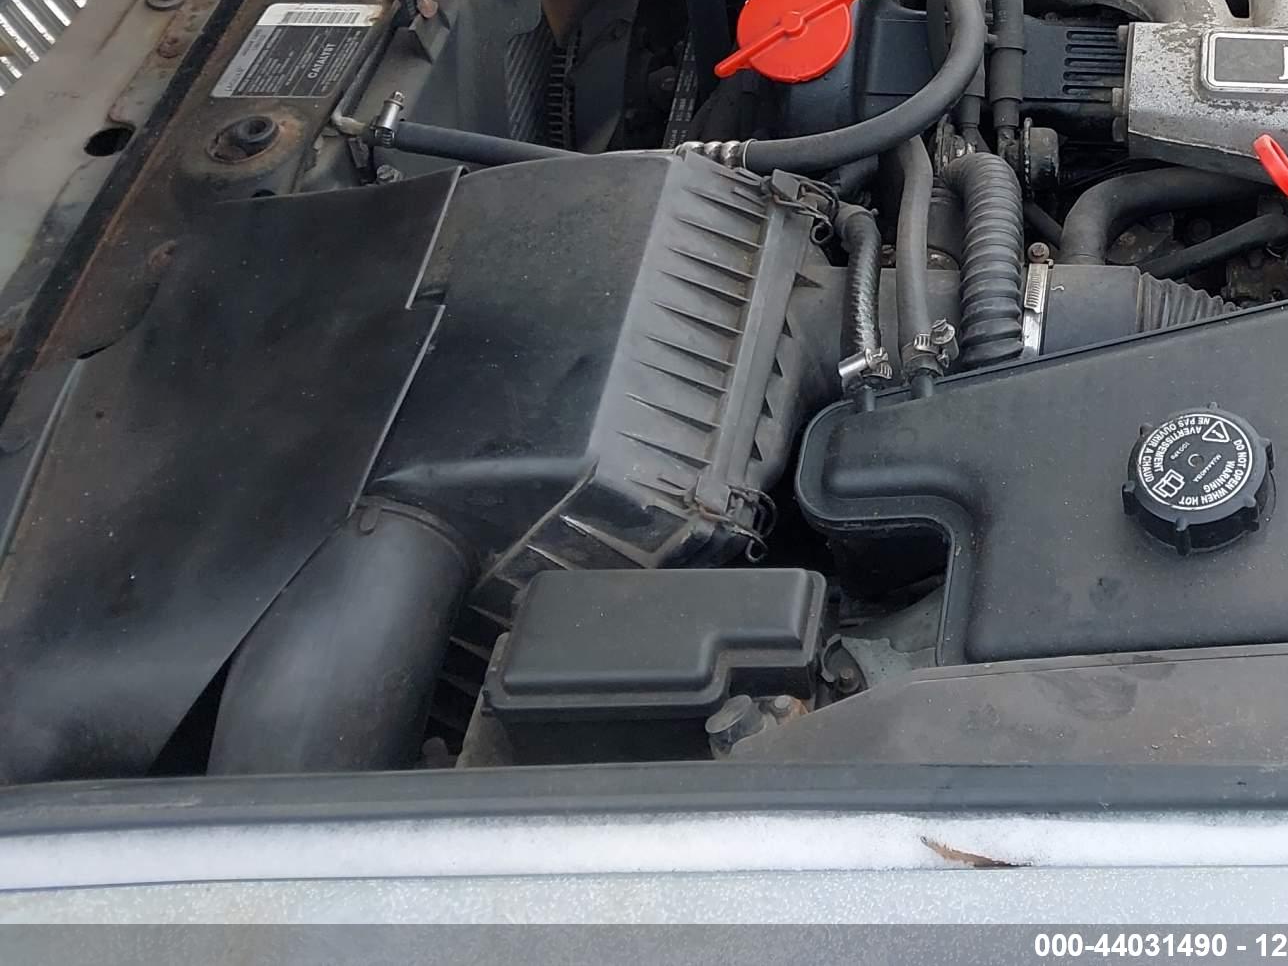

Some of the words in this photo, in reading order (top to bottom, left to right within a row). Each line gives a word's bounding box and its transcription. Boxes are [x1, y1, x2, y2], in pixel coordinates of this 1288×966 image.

[1177, 418, 1197, 429] PAS
[1198, 416, 1211, 426] NE
[1148, 423, 1178, 448] OUVRIR
[1232, 438, 1245, 452] DO
[1153, 426, 1201, 472] AVERTISSEMENT
[1141, 455, 1155, 483] CHAUD
[1236, 451, 1248, 470] NOT
[1202, 459, 1236, 494] WARNING
[1227, 469, 1245, 491] OPEN
[1178, 495, 1200, 507] HOT
[1200, 485, 1229, 505] WHEN
